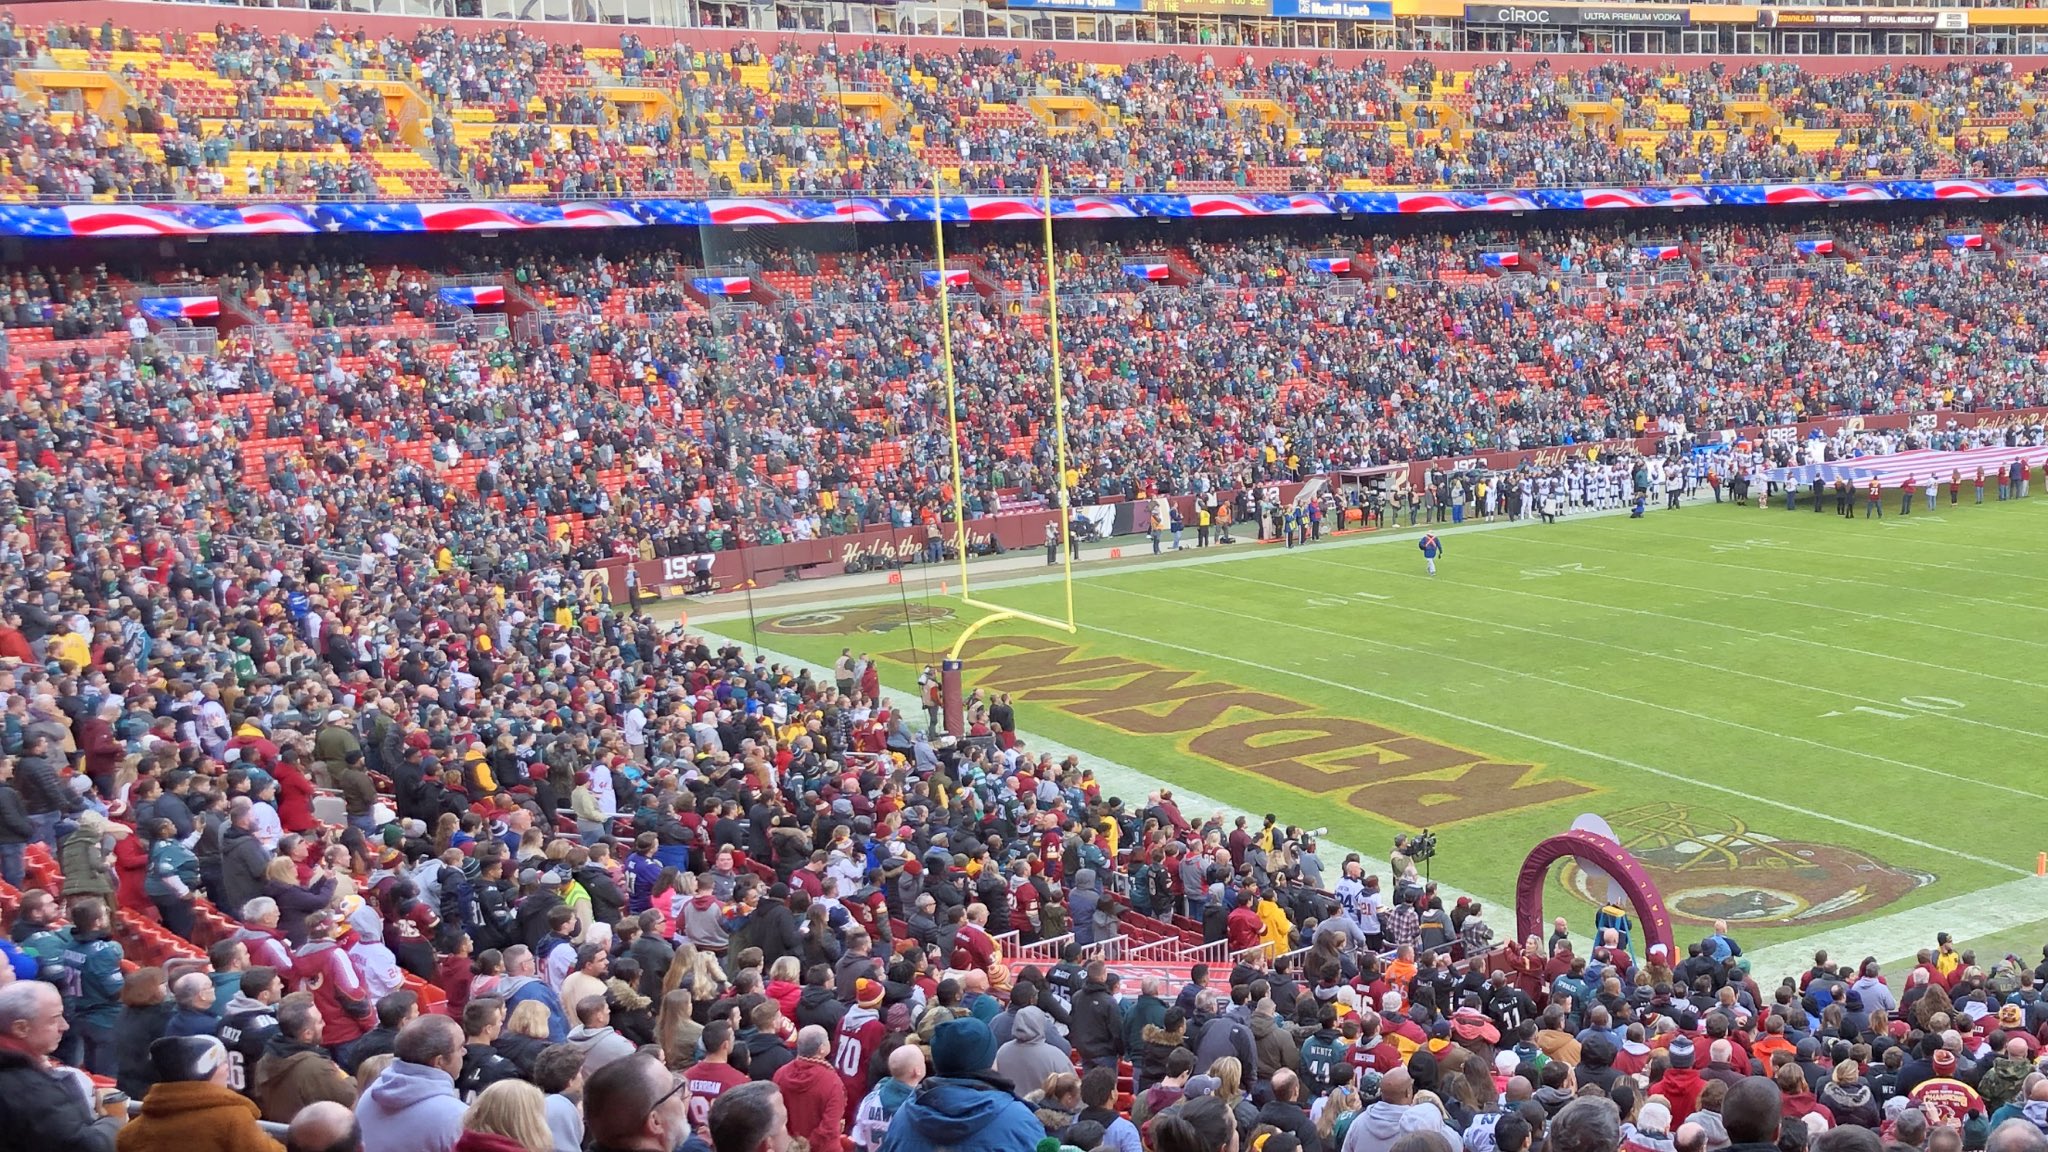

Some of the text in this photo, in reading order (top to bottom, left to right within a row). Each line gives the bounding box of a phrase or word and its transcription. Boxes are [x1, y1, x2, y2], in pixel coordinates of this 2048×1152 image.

[1164, 2, 1179, 12] THE
[1311, 3, 1342, 15] Merrill
[1343, 4, 1370, 17] Lynch
[1584, 12, 1681, 22] ULTRA PREMIUM VODKA
[1778, 15, 1815, 23] DOWNLOAD
[1815, 15, 1828, 23] THE
[1868, 16, 1935, 24] OFFICIAL MOBILE APP
[1767, 426, 1798, 442] 1982
[1870, 488, 1879, 496] 71
[881, 541, 897, 558] to
[898, 534, 923, 558] the
[879, 634, 1598, 829] REDSKINS
[1616, 854, 1633, 871] TO
[1360, 902, 1372, 916] 21
[1640, 881, 1665, 927] HAIL
[1503, 1007, 1521, 1030] 11
[835, 1033, 862, 1077] 70
[1310, 1045, 1333, 1057] WENTZ
